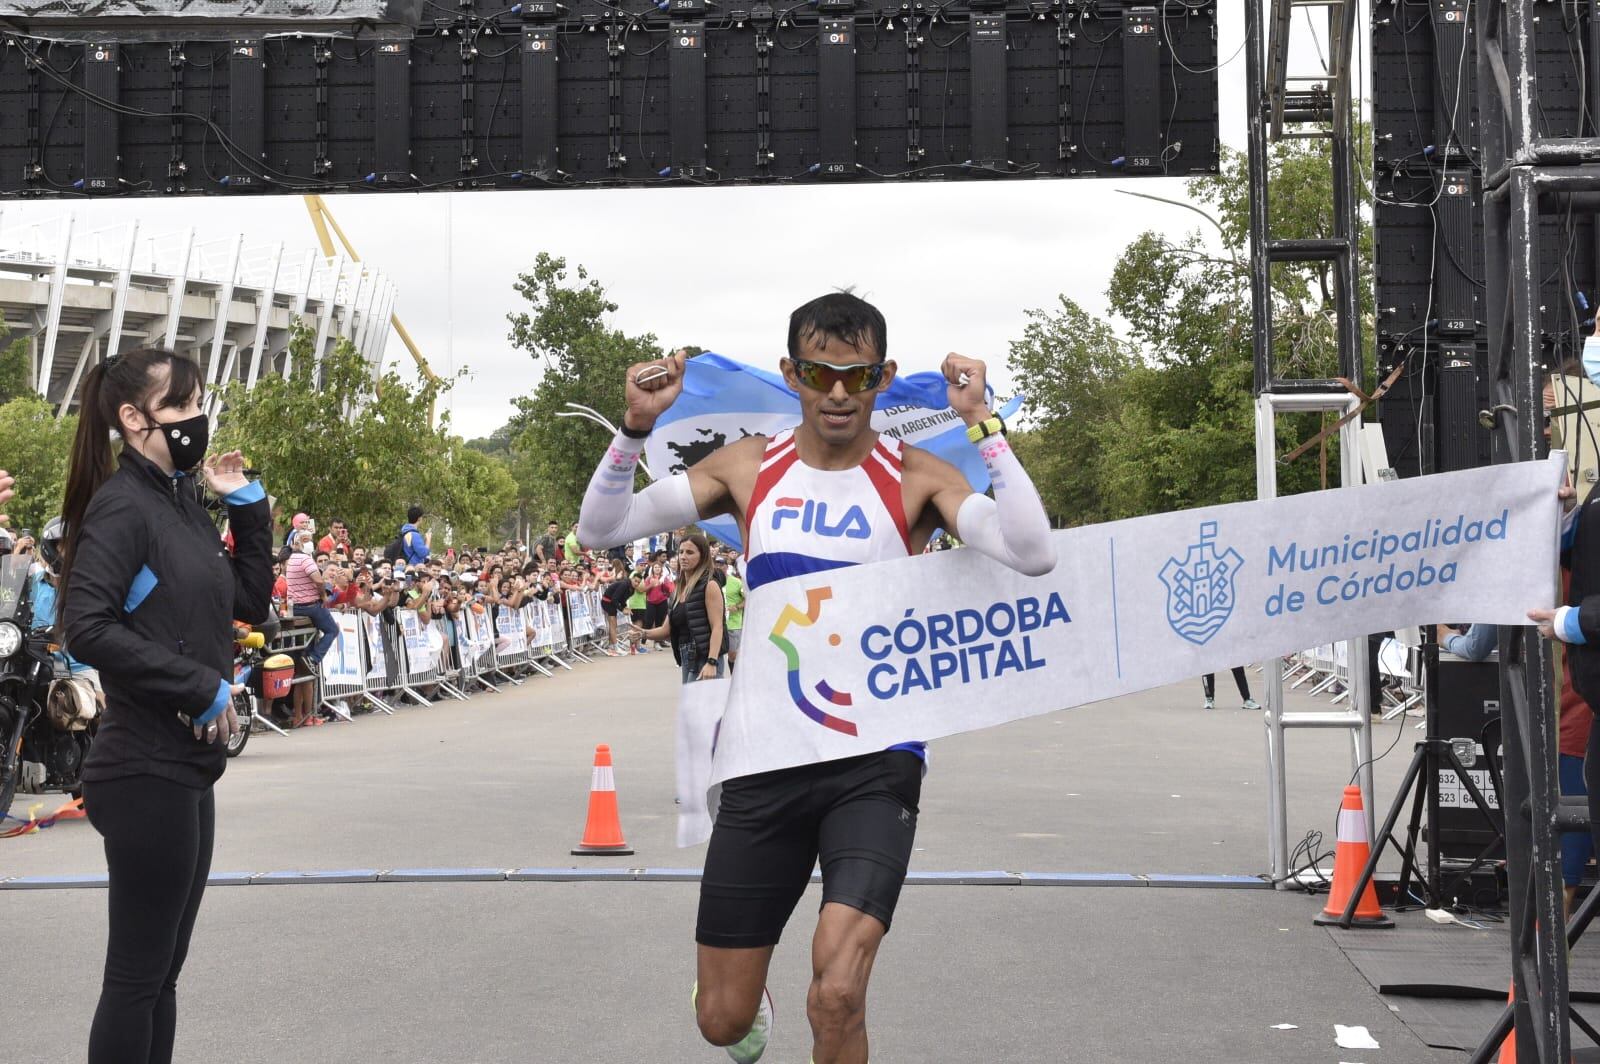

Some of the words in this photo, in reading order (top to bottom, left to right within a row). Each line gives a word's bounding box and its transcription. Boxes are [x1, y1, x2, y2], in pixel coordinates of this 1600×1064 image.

[529, 4, 544, 12] 374
[677, 0, 693, 8] 549
[1134, 158, 1150, 166] 539
[828, 164, 844, 172] 490
[91, 180, 106, 188] 683
[1447, 321, 1464, 329] 429
[772, 496, 872, 540] FILA
[1268, 509, 1509, 577] Municipalidad
[1264, 584, 1306, 617] de
[1316, 558, 1458, 606] Córdoba
[860, 592, 1072, 661] CÓRDOBA
[867, 636, 1047, 700] CAPITAL
